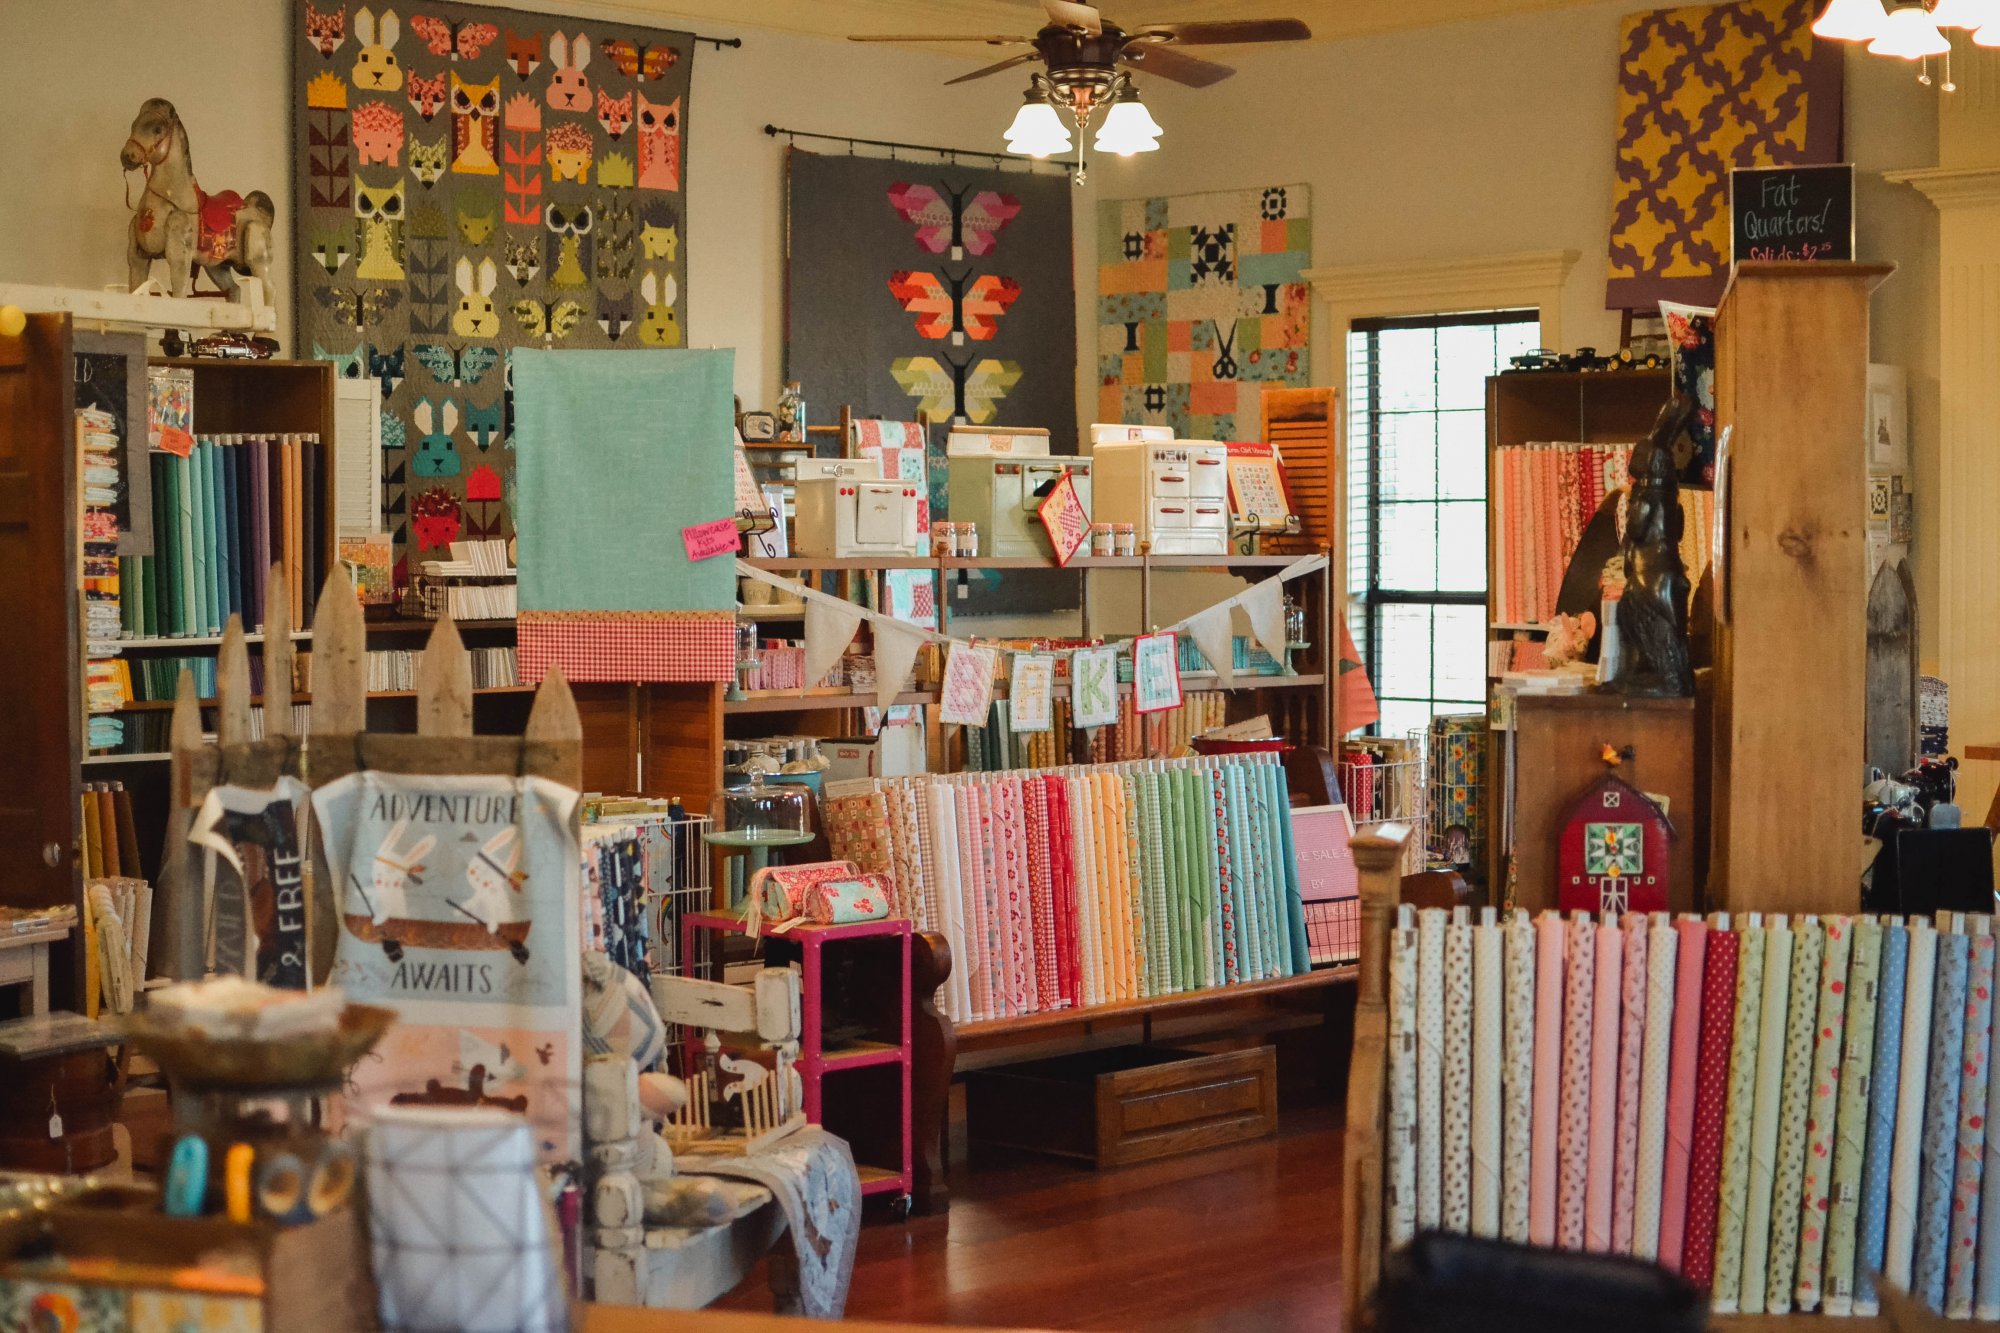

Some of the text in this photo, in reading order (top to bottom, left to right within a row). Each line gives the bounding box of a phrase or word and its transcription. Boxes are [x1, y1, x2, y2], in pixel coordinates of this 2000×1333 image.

[1761, 174, 1801, 208] Fat
[1744, 198, 1832, 240] Quarters!
[1312, 849, 1339, 861] SALE
[273, 848, 303, 932] FREE
[1311, 879, 1325, 889] BY
[390, 960, 493, 994] AWAITS
